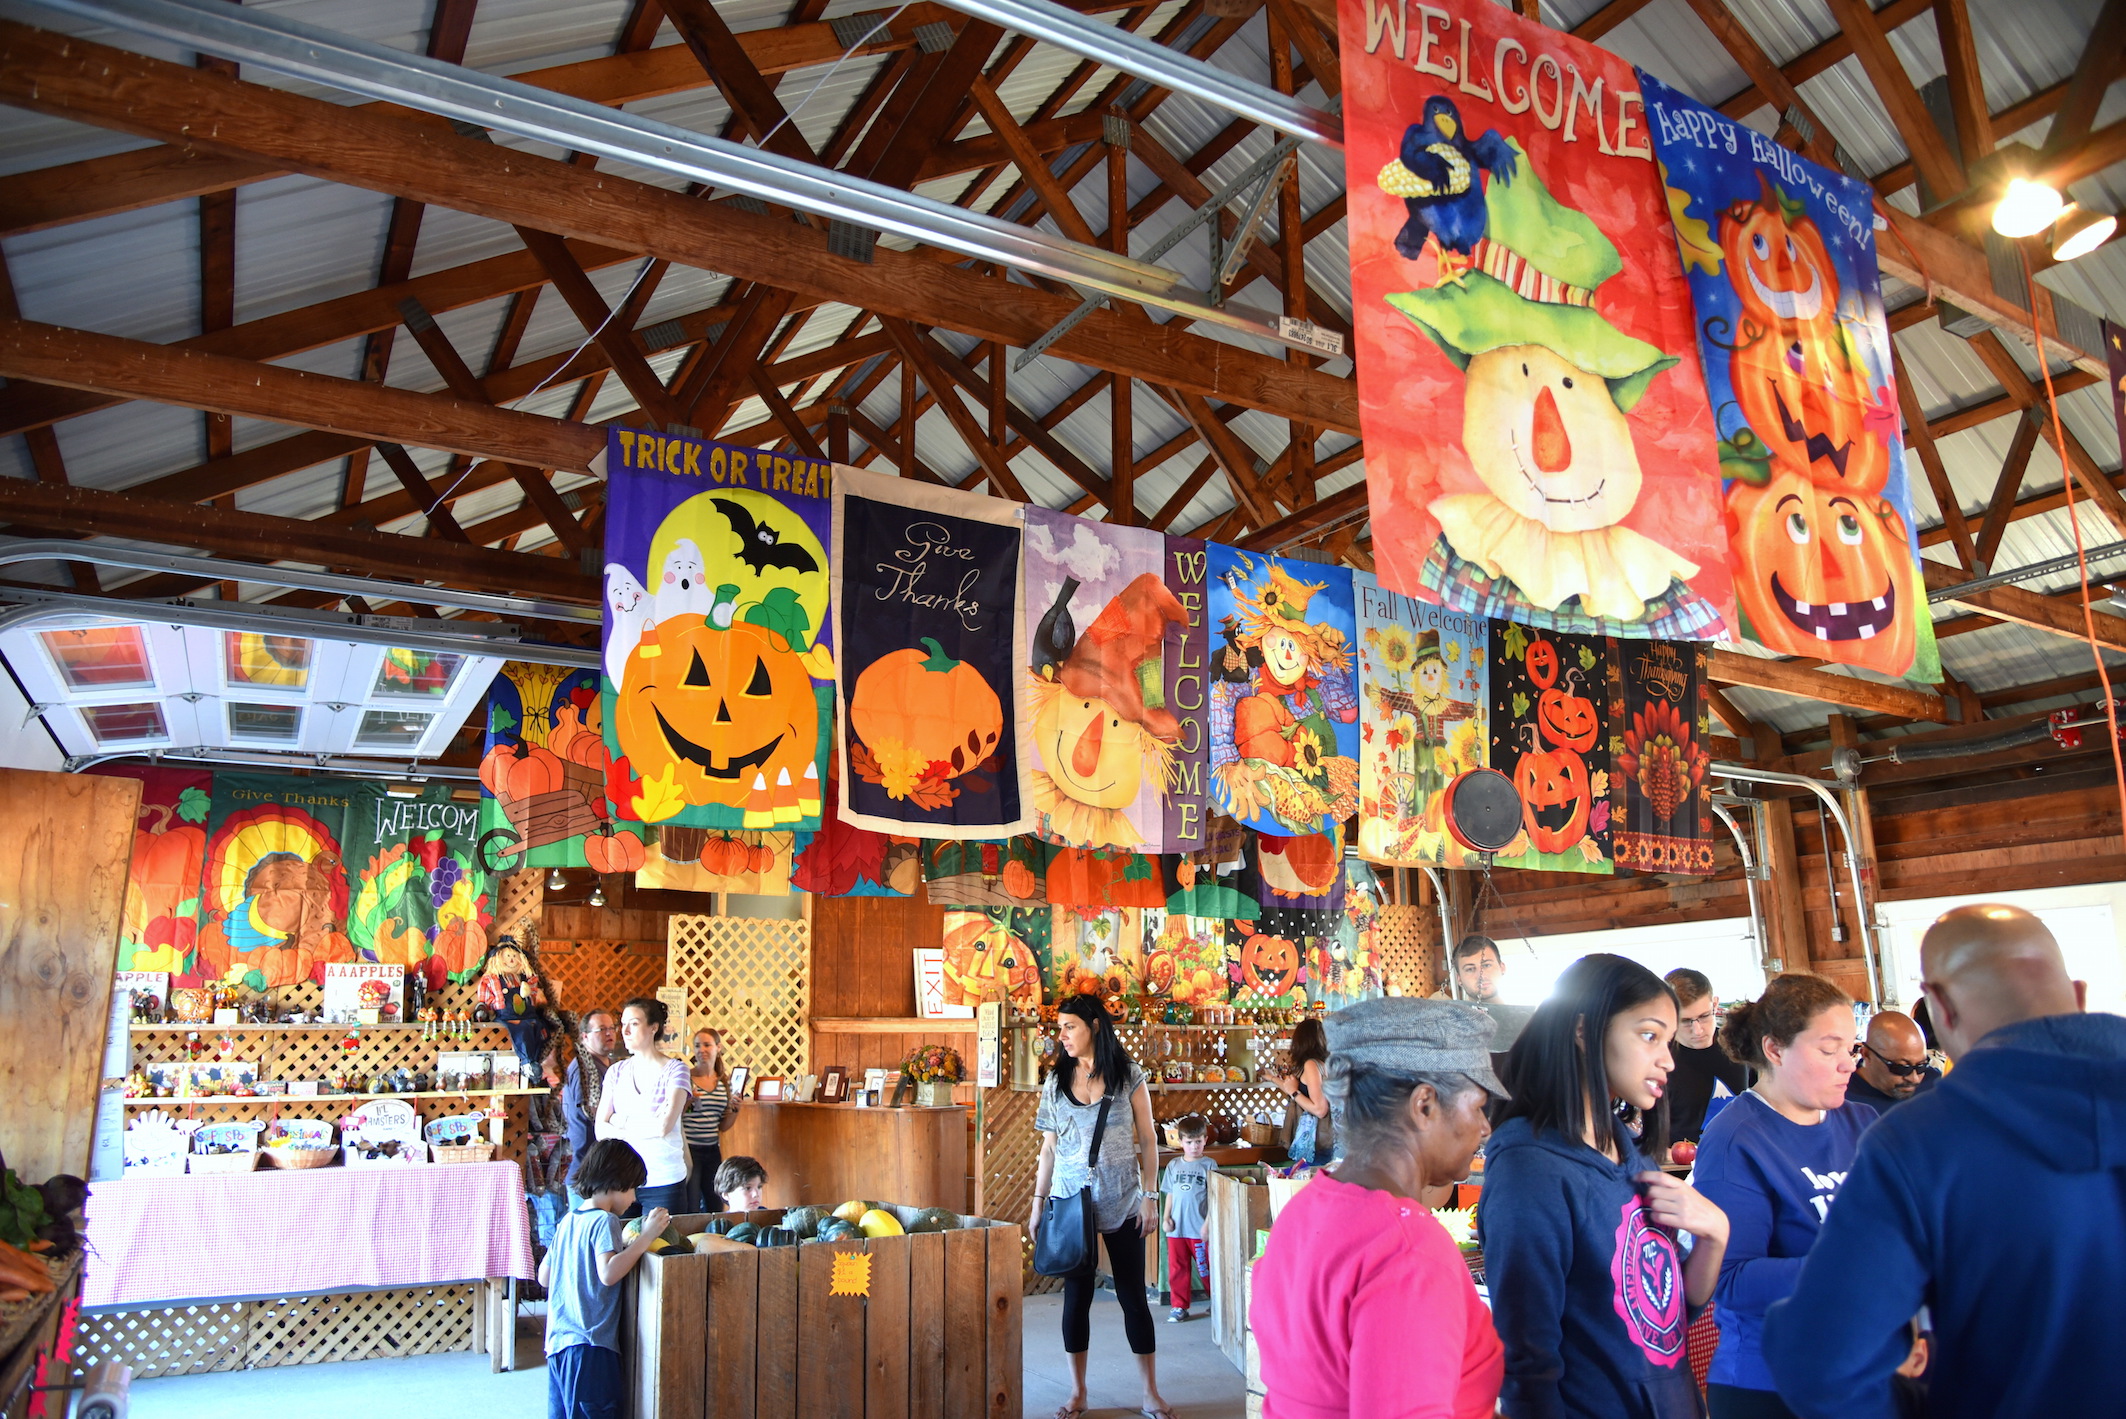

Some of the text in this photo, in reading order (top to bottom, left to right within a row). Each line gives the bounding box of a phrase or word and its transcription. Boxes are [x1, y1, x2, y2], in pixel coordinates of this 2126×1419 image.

[1364, 0, 1652, 162] WELCOME
[619, 430, 831, 499] TRICK OR TREAT
[894, 521, 976, 564] Give
[874, 561, 983, 632] Thanks
[1362, 586, 1487, 640] Fall Welcome
[1629, 653, 1689, 703] Thanksgiving
[1649, 640, 1683, 670] Happy
[1173, 551, 1207, 842] WELCOME
[232, 788, 351, 807] Give Thanks
[375, 797, 479, 848] WELCOM
[115, 973, 163, 983] APPLE
[924, 954, 943, 1015] EXIT
[1173, 1173, 1205, 1186] JETS
